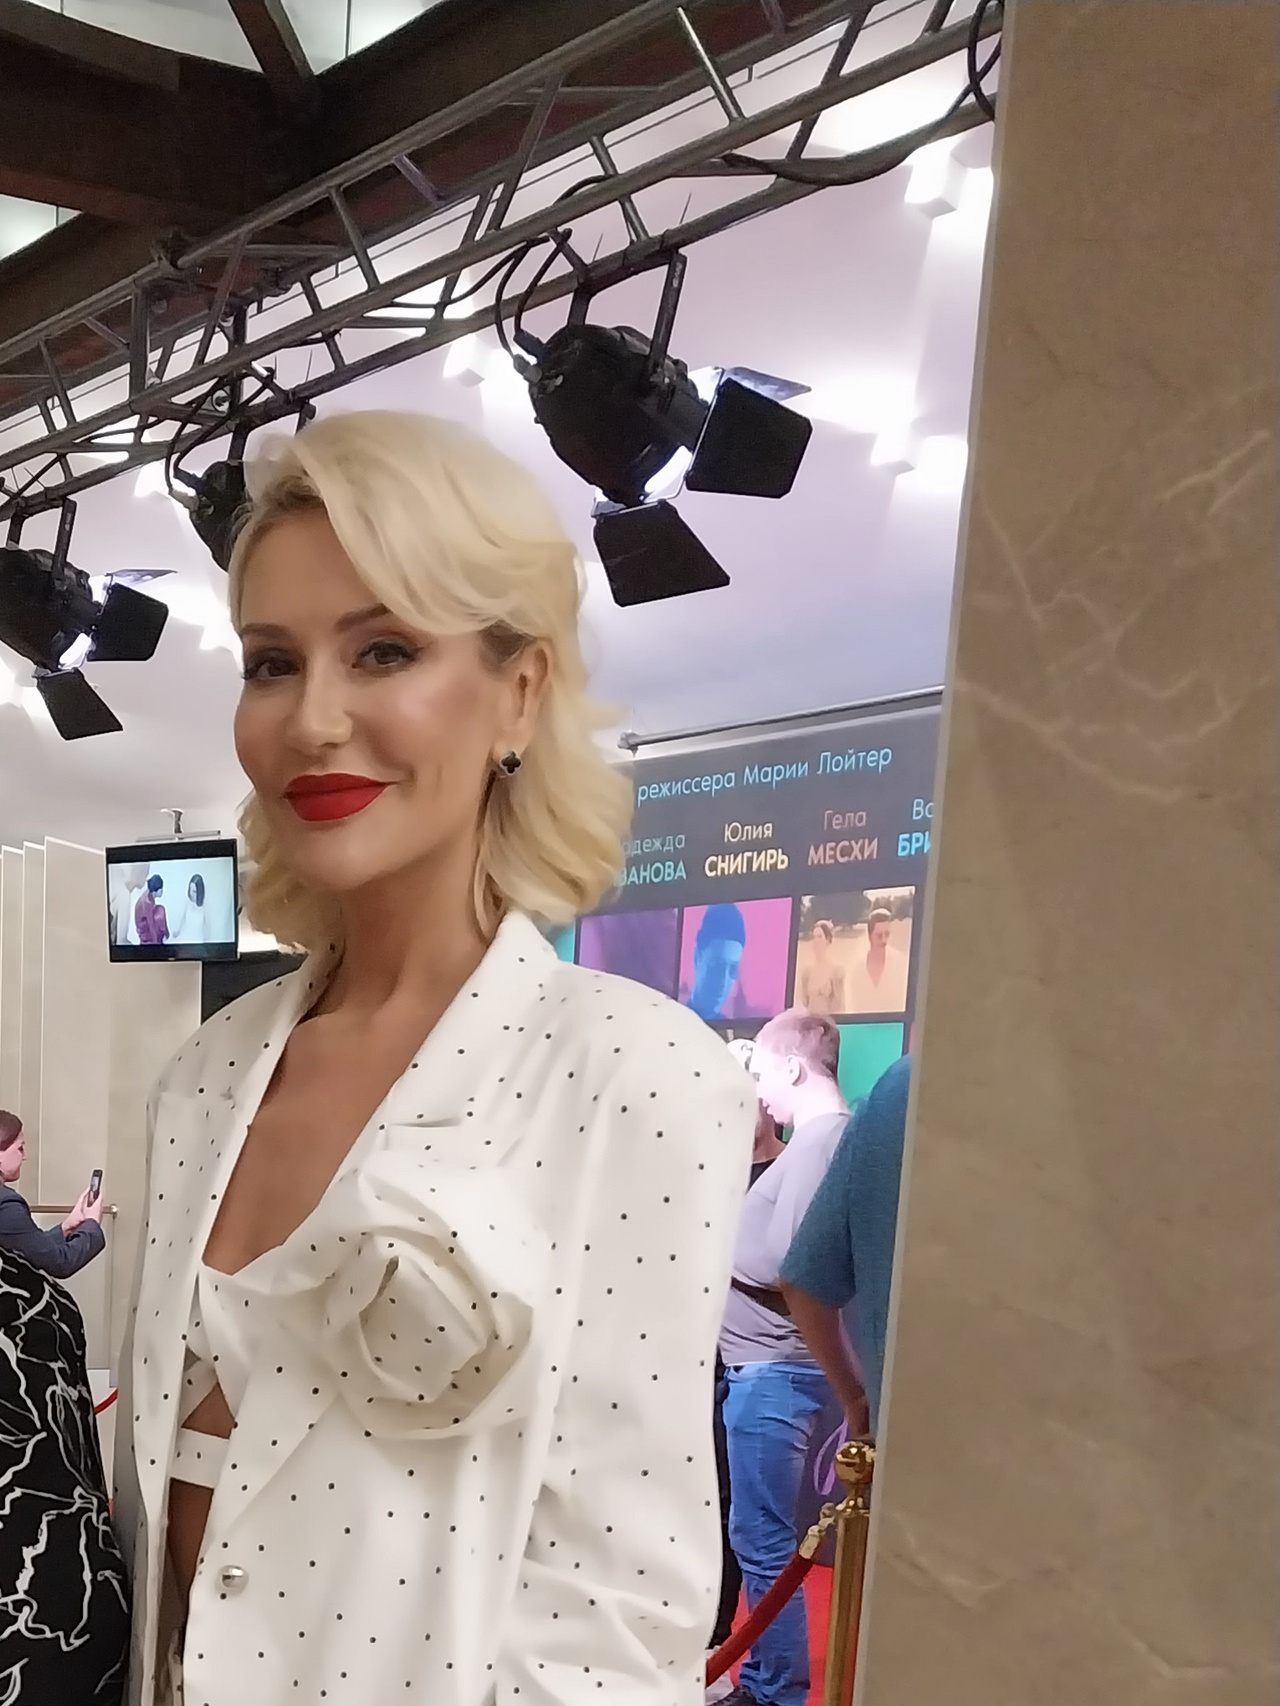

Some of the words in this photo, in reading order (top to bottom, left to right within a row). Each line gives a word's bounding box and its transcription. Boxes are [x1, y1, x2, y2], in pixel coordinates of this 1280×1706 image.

[637, 770, 735, 807] режиссера
[743, 760, 809, 790] Марии
[816, 746, 893, 775] Лойтер
[623, 834, 686, 857] адежда
[724, 821, 773, 844] Юлия
[823, 808, 867, 832] Гела
[704, 847, 789, 878] СНИГИРЬ
[807, 837, 879, 866] МЕСХИ
